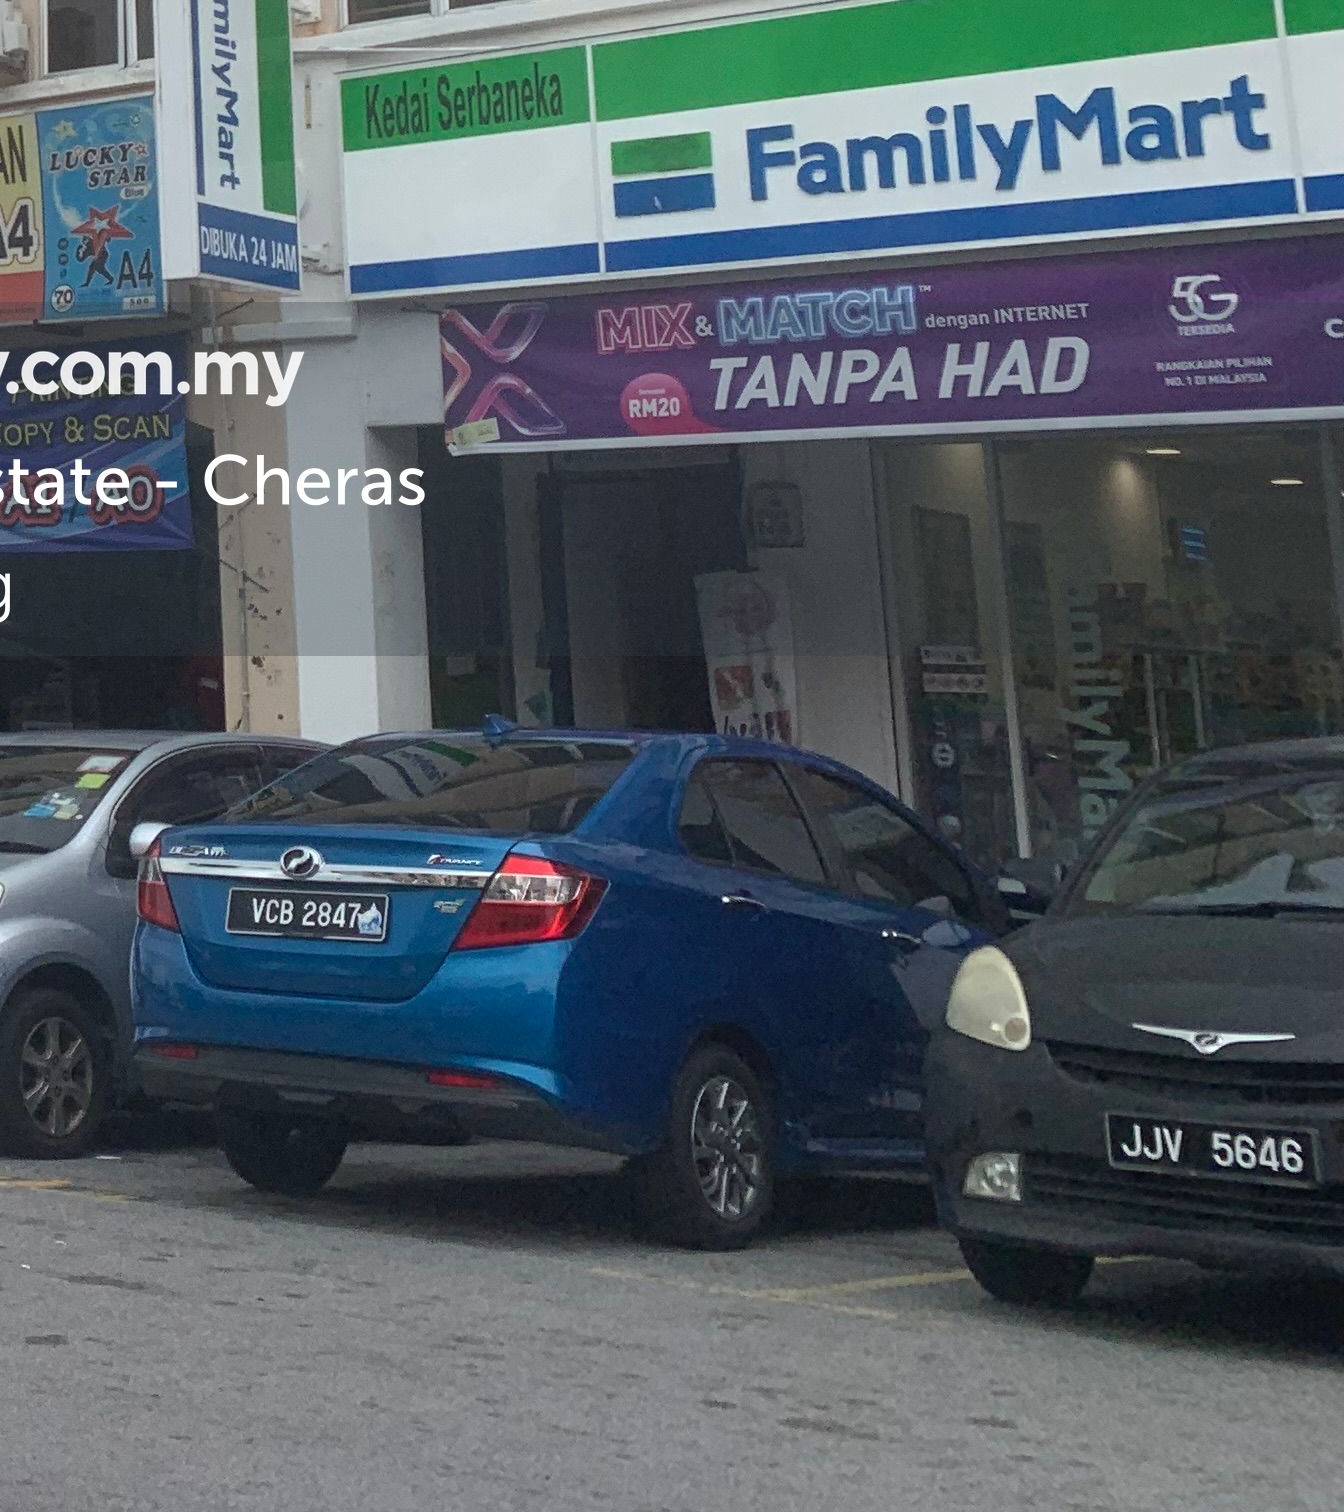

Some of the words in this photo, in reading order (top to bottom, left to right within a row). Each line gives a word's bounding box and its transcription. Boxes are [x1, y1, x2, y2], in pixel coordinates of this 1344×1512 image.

[364, 77, 432, 139] Kedai
[436, 63, 565, 133] Serbaneka
[745, 73, 1273, 202] FamilyMart
[49, 141, 135, 172] LUCKY
[88, 164, 147, 188] STAR
[199, 225, 248, 265] DIBUKA
[250, 236, 268, 266] 24
[270, 241, 298, 274] JAM
[116, 247, 154, 290] A4
[54, 289, 73, 306] 70
[1167, 273, 1240, 323] 5G
[596, 301, 696, 354] MIX
[695, 314, 716, 337] &
[924, 310, 991, 330] dengan
[993, 302, 1090, 325] INTERNET
[709, 346, 919, 411] TANPA
[937, 335, 1091, 399] HAD
[1155, 358, 1224, 374] RANGKAIAN
[1225, 355, 1274, 371] PILIHAN
[1208, 371, 1268, 386] MALAYSIA
[628, 396, 681, 419] RM20
[64, 415, 85, 444] &
[93, 413, 171, 442] SCAN
[252, 897, 294, 925] VCB
[301, 900, 361, 929] 2847
[1120, 1122, 1184, 1164] JJV
[1211, 1131, 1304, 1174] 5646
